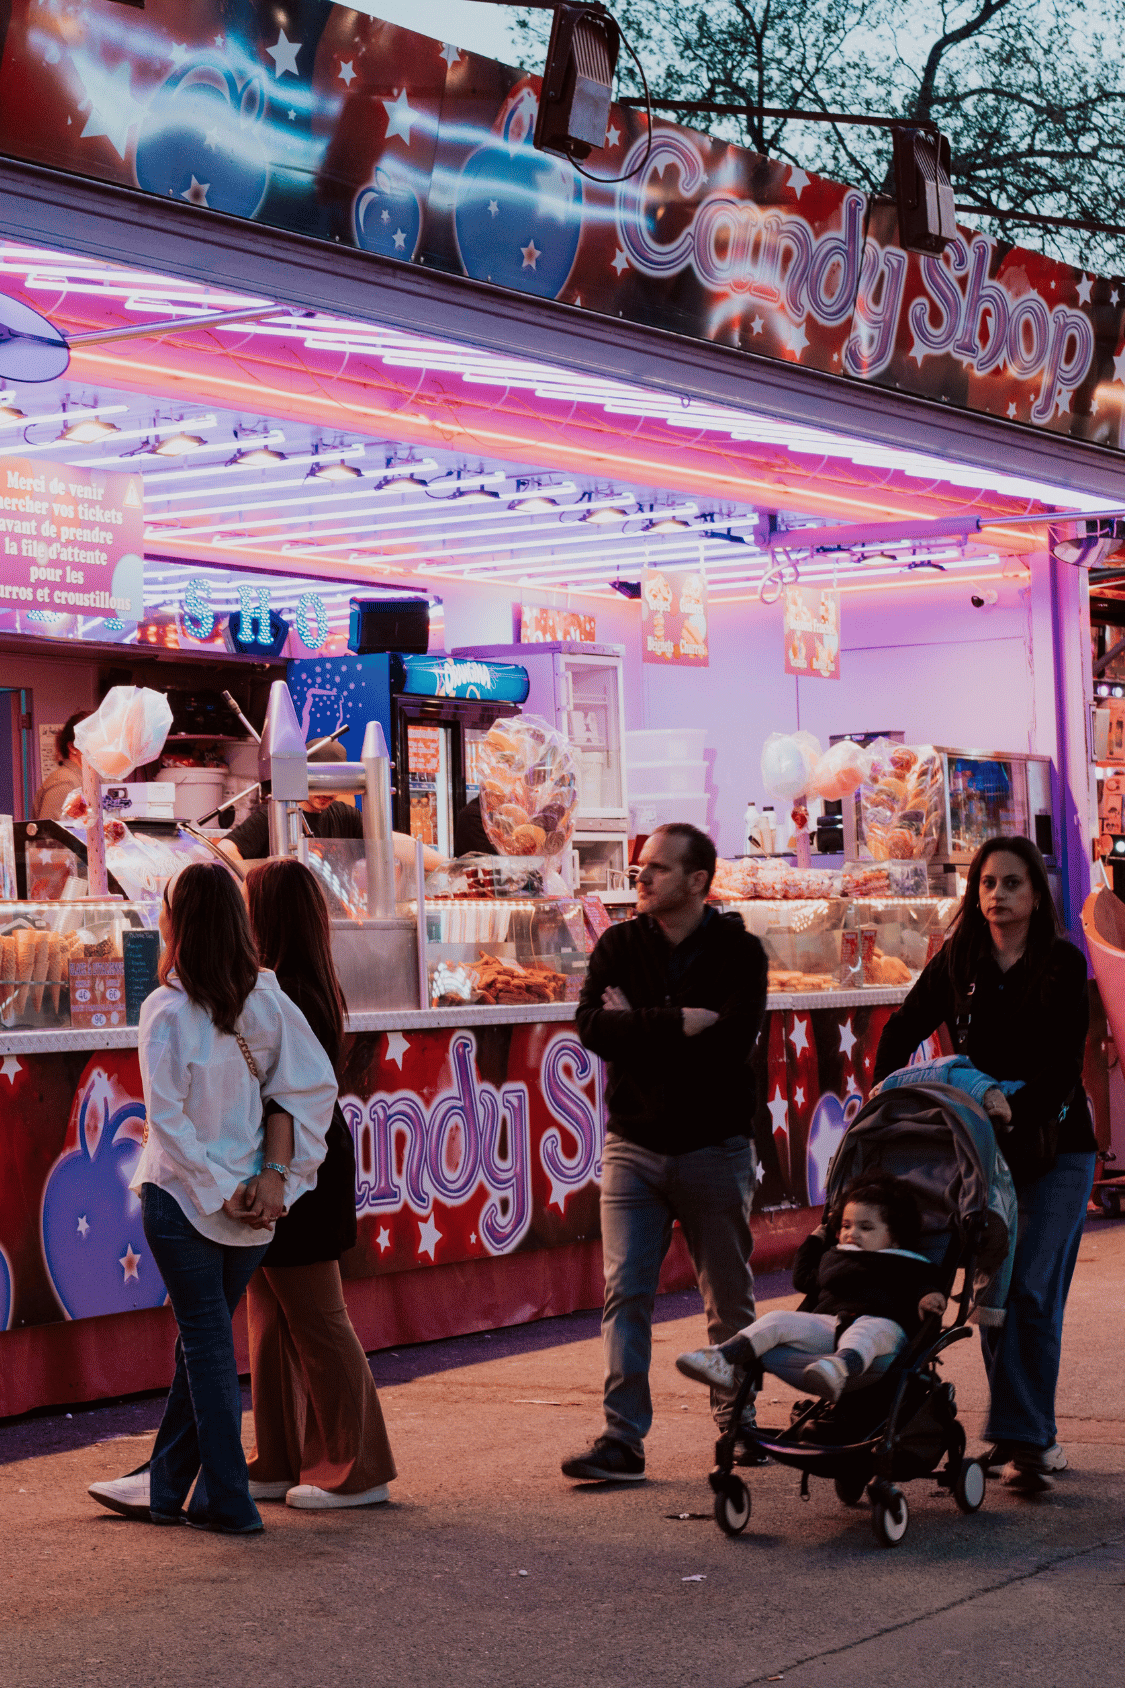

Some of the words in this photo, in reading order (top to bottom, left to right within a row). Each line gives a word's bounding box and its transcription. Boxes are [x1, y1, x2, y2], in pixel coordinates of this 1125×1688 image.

[616, 127, 907, 379] Candy
[909, 235, 1094, 424] Shop
[6, 470, 46, 493] Merci
[48, 477, 66, 496] de
[68, 483, 105, 501] venir
[52, 503, 75, 519] vos
[77, 503, 123, 525] tickets
[40, 520, 58, 538] de
[60, 526, 114, 545] prendre
[4, 537, 18, 556] la
[21, 538, 45, 559] file
[48, 542, 108, 566] d'attente
[29, 566, 63, 583] pour
[65, 566, 85, 585] les
[36, 587, 51, 603] et
[53, 588, 132, 612] croustillons
[184, 578, 329, 650] SHO
[340, 1030, 532, 1255] ndy
